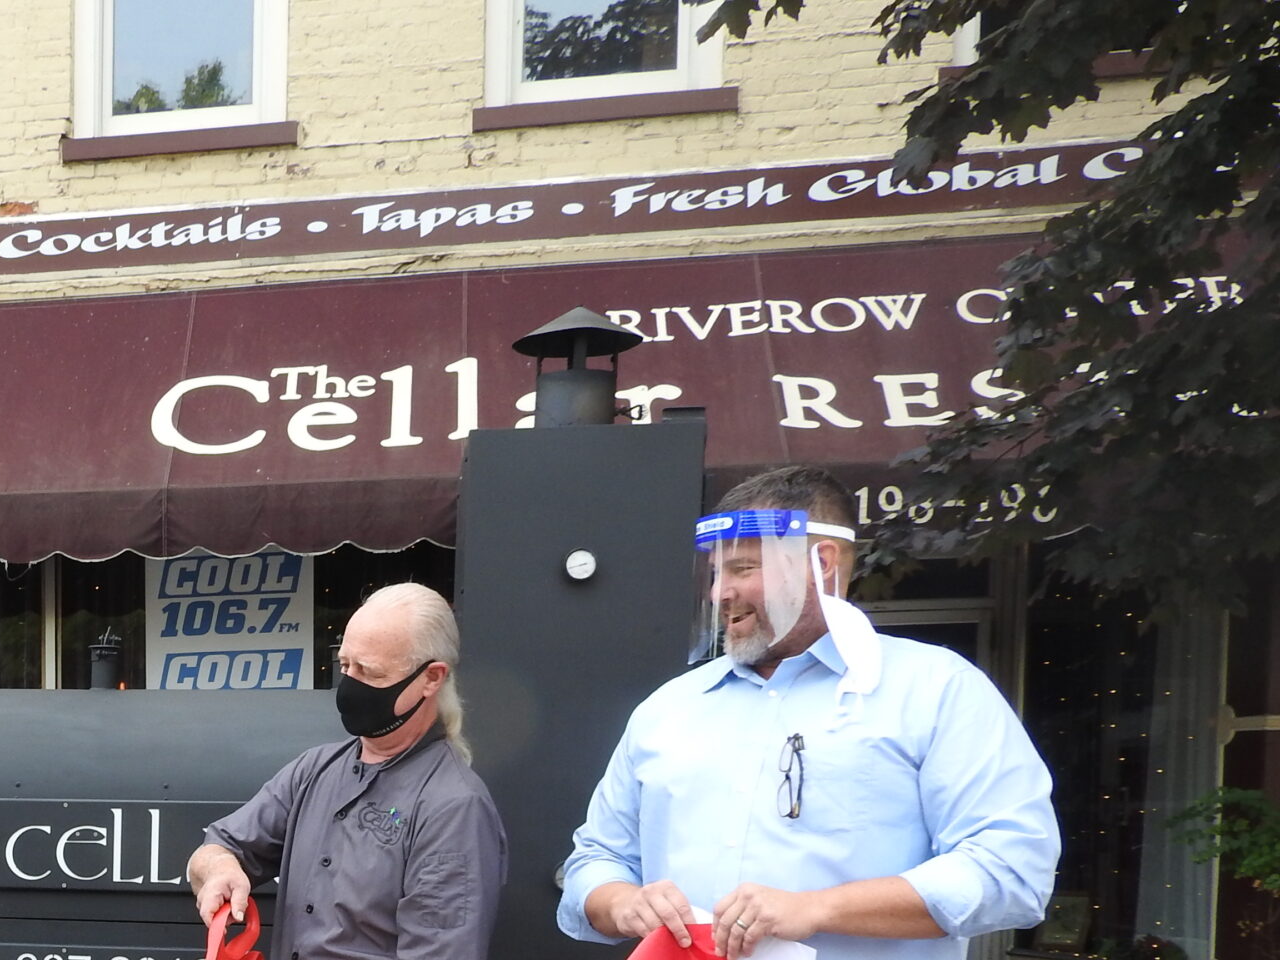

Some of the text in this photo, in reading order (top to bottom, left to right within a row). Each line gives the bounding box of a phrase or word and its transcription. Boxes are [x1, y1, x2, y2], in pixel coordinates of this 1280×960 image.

[351, 200, 535, 238] Tapas
[610, 177, 793, 217] Fresh
[808, 154, 1067, 201] Global
[605, 293, 927, 342] RIVEROW
[270, 364, 376, 398] The
[164, 555, 294, 596] COOL
[160, 597, 300, 637] 106.7 FM
[165, 652, 294, 690] COOL
